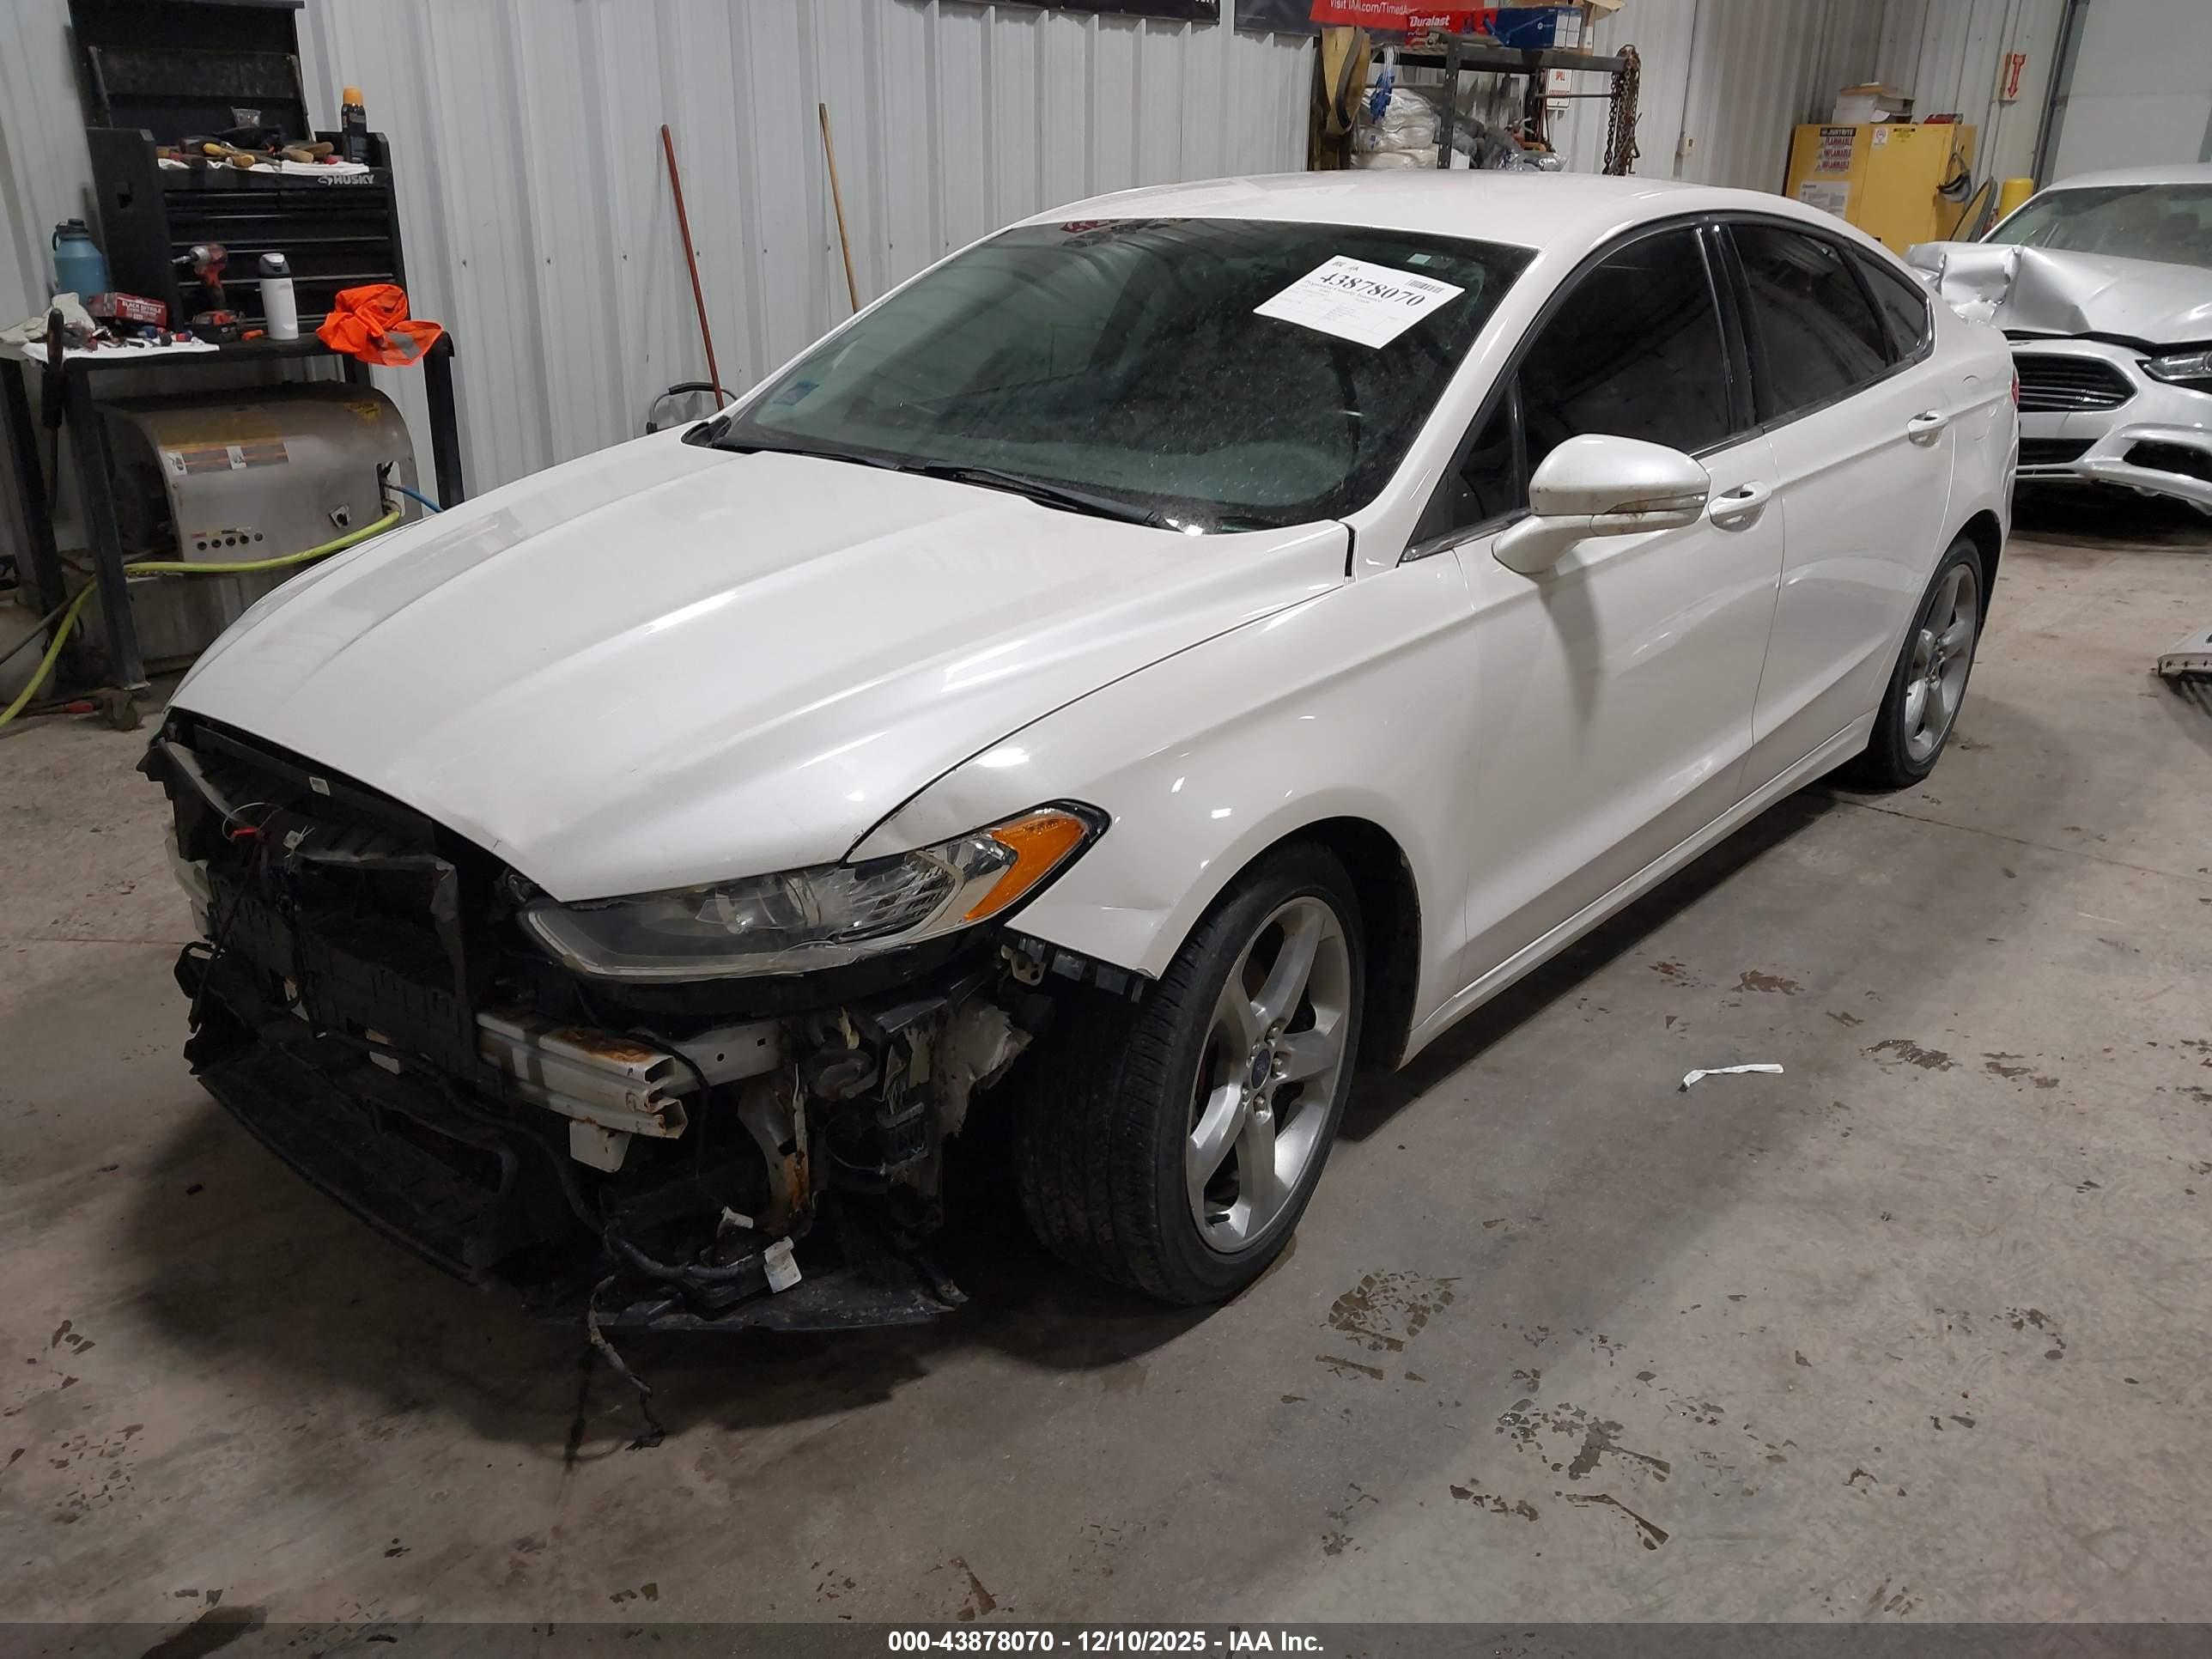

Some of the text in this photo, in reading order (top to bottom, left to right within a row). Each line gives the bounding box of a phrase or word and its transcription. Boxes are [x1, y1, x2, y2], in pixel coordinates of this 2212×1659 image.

[1409, 15, 1449, 27] Duralast
[333, 174, 374, 185] HUSKY
[1320, 272, 1426, 307] 43878070
